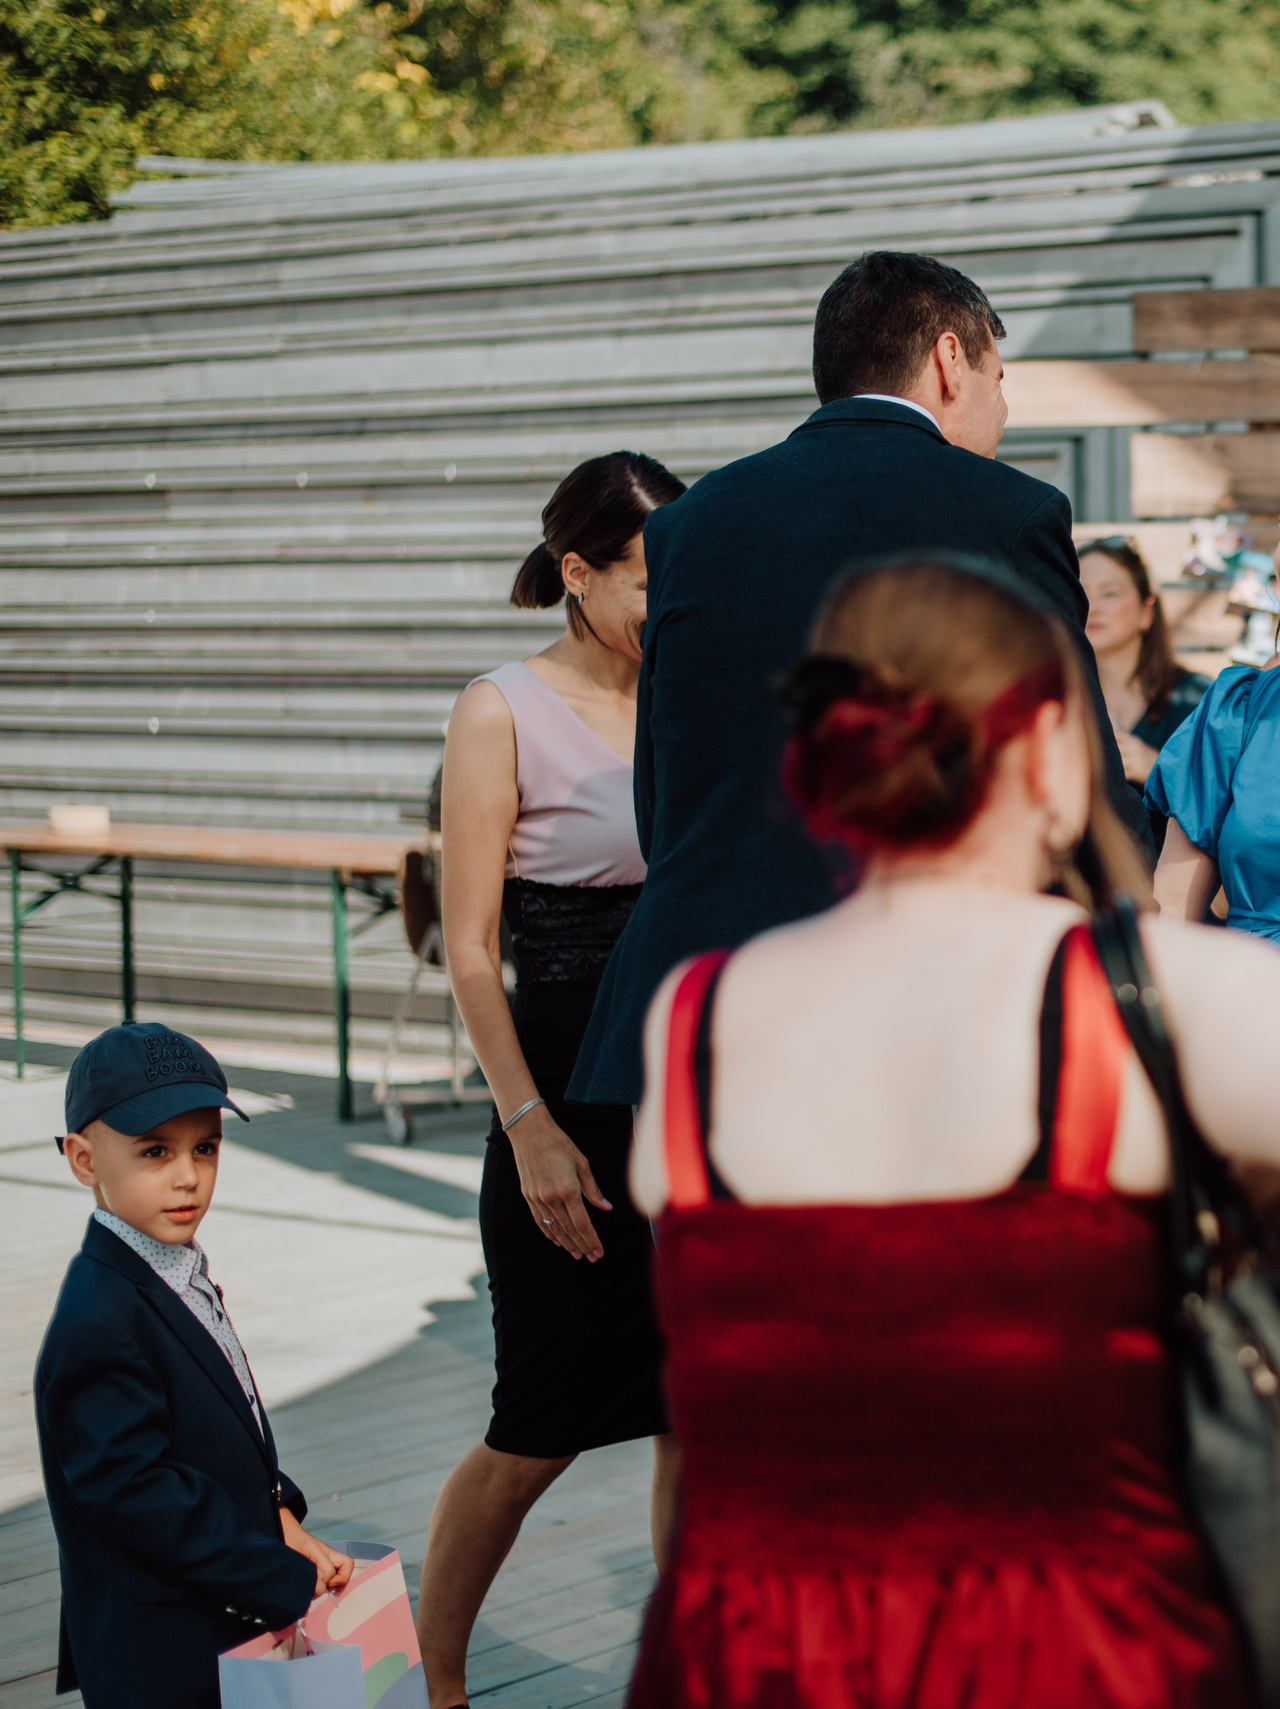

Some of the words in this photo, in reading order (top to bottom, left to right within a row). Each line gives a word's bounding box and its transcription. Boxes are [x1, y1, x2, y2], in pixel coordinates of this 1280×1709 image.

[144, 1035, 184, 1049] BIM
[146, 1047, 194, 1064] BAM
[145, 1060, 205, 1082] BOOM
